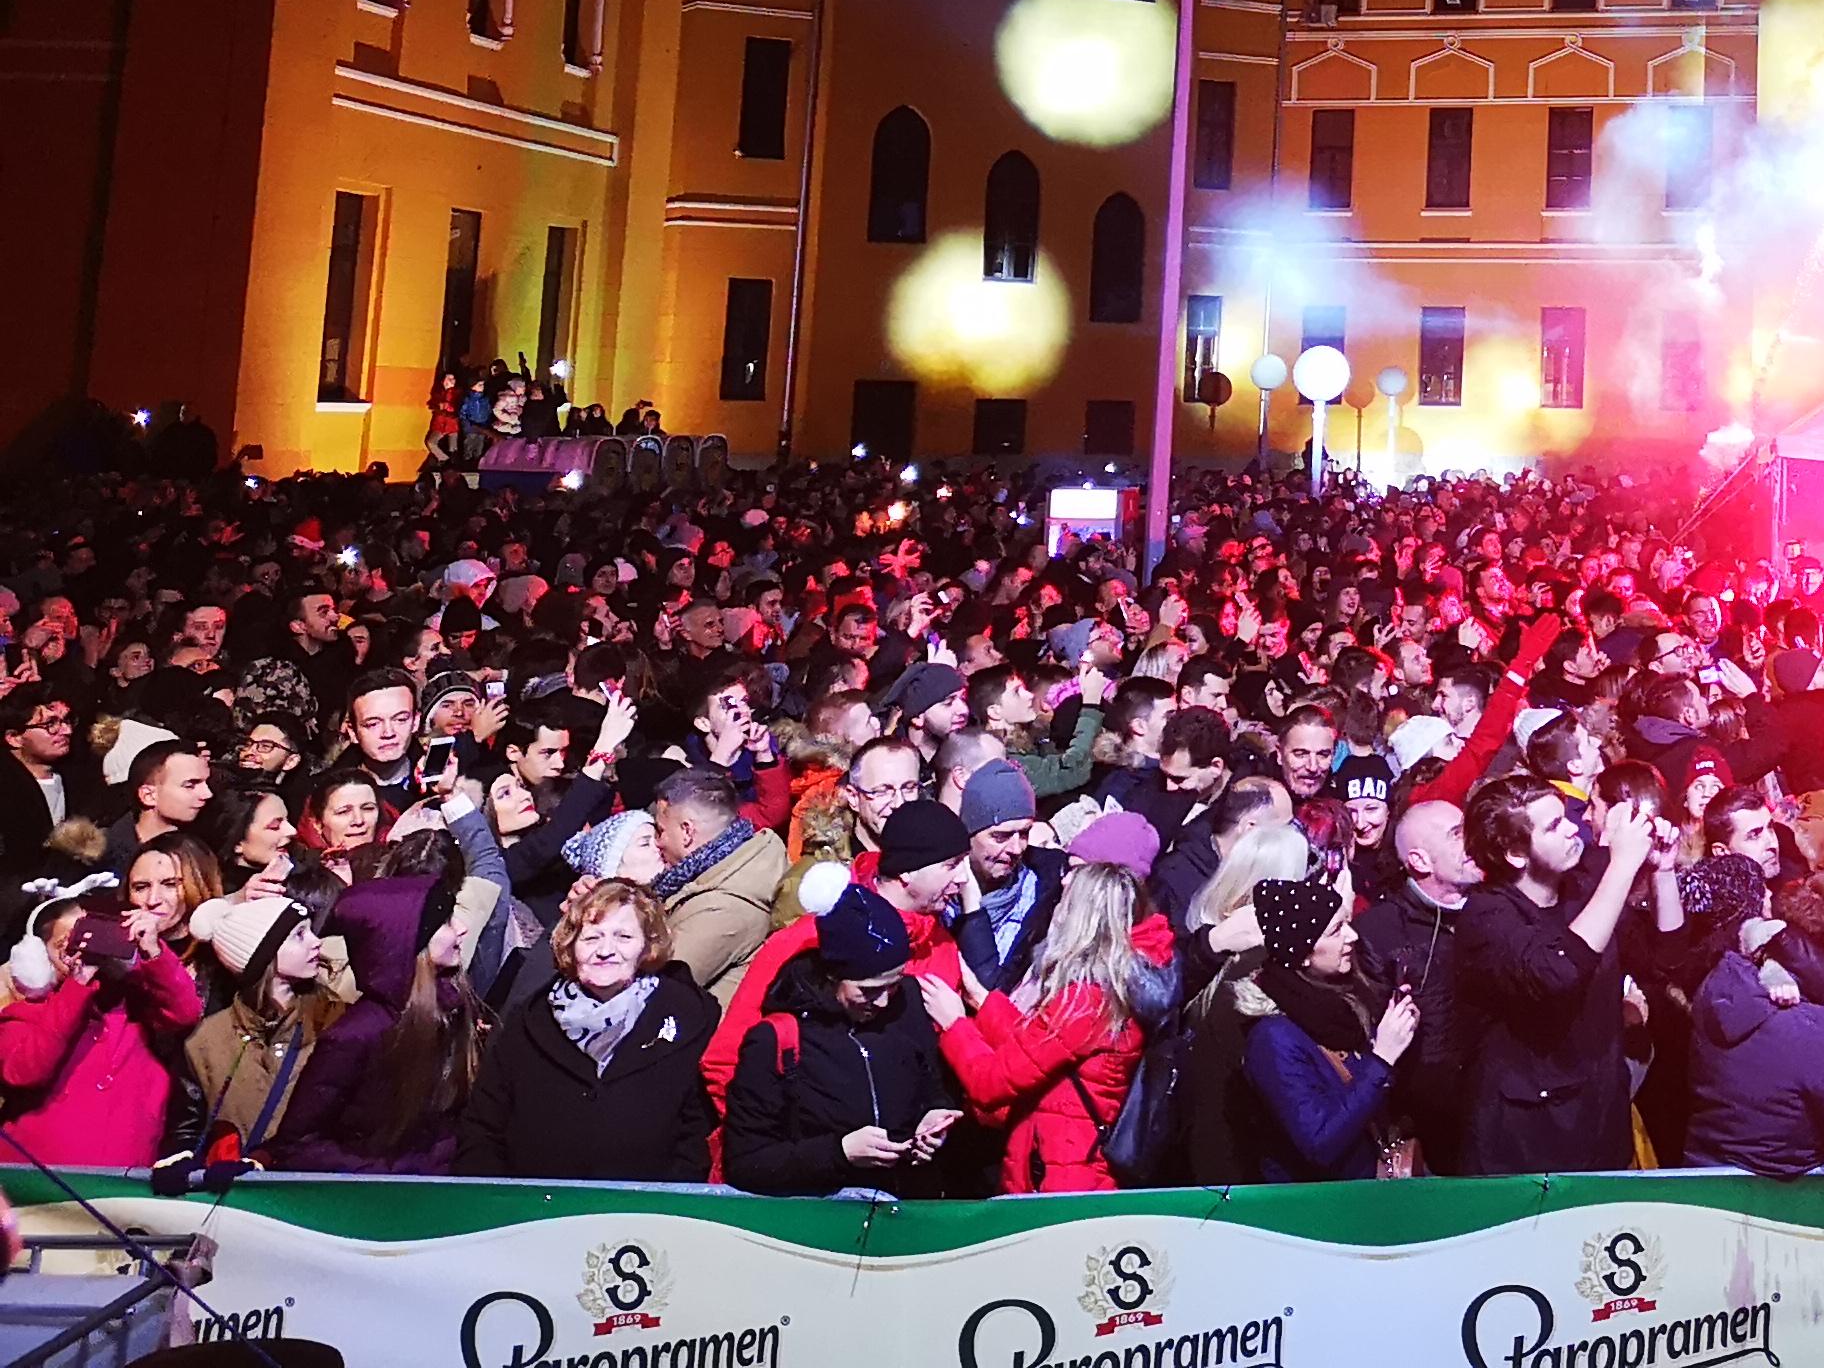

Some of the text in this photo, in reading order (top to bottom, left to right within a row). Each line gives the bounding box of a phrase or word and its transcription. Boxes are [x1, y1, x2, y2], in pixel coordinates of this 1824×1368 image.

[1348, 777, 1387, 799] BAD
[1602, 1232, 1647, 1296] S
[605, 1244, 652, 1311] S
[1106, 1245, 1154, 1310] S
[1610, 1298, 1638, 1311] 1869
[612, 1314, 641, 1326] 1869
[1114, 1312, 1144, 1325] 1869
